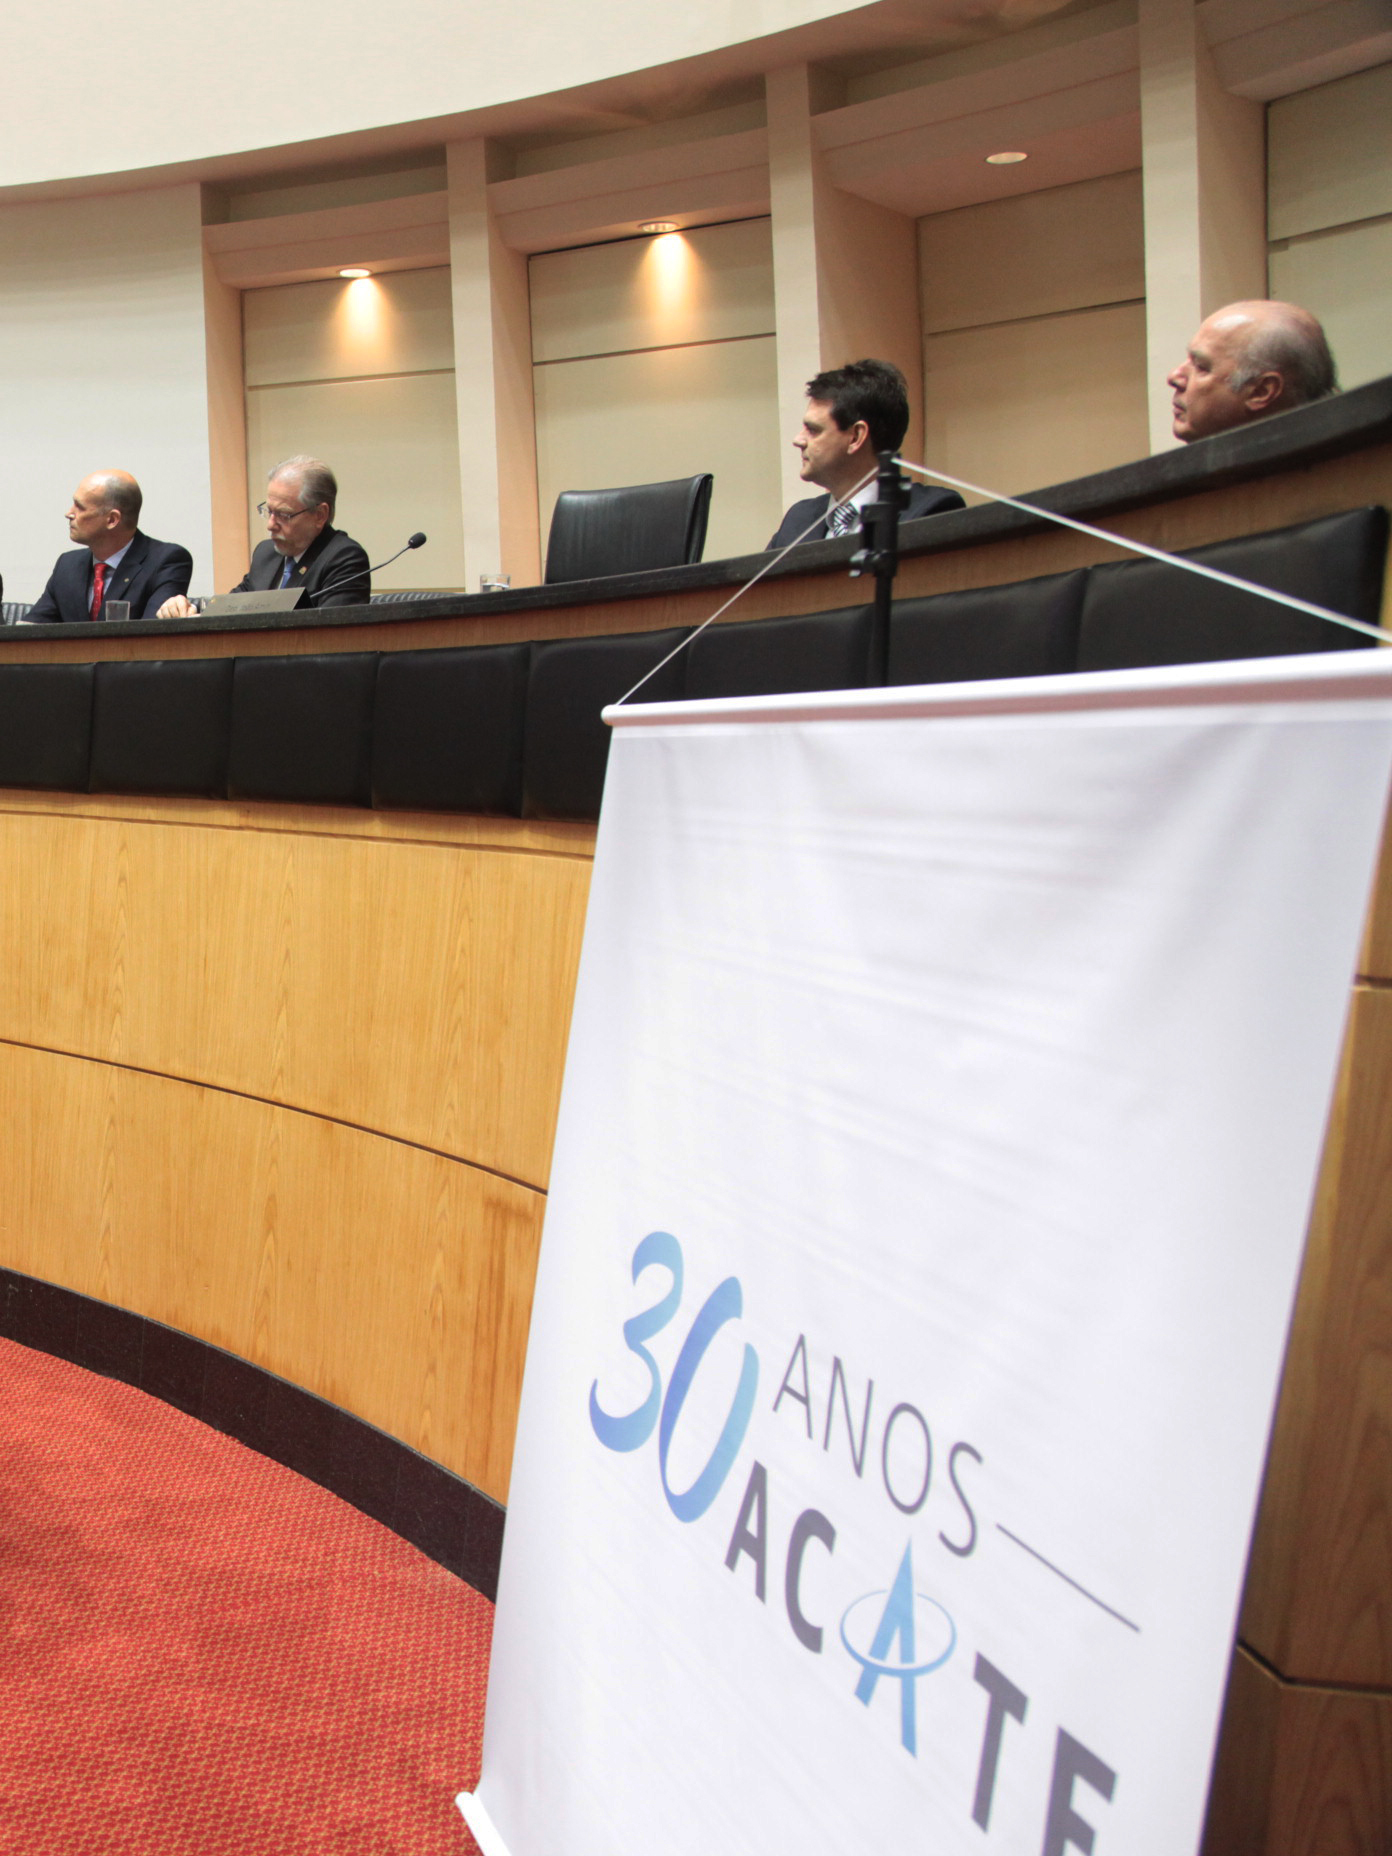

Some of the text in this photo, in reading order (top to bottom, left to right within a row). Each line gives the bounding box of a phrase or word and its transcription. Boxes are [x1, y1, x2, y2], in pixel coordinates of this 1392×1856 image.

[589, 1231, 983, 1557] 30 ANOS
[724, 1460, 1118, 1856] ACATE
